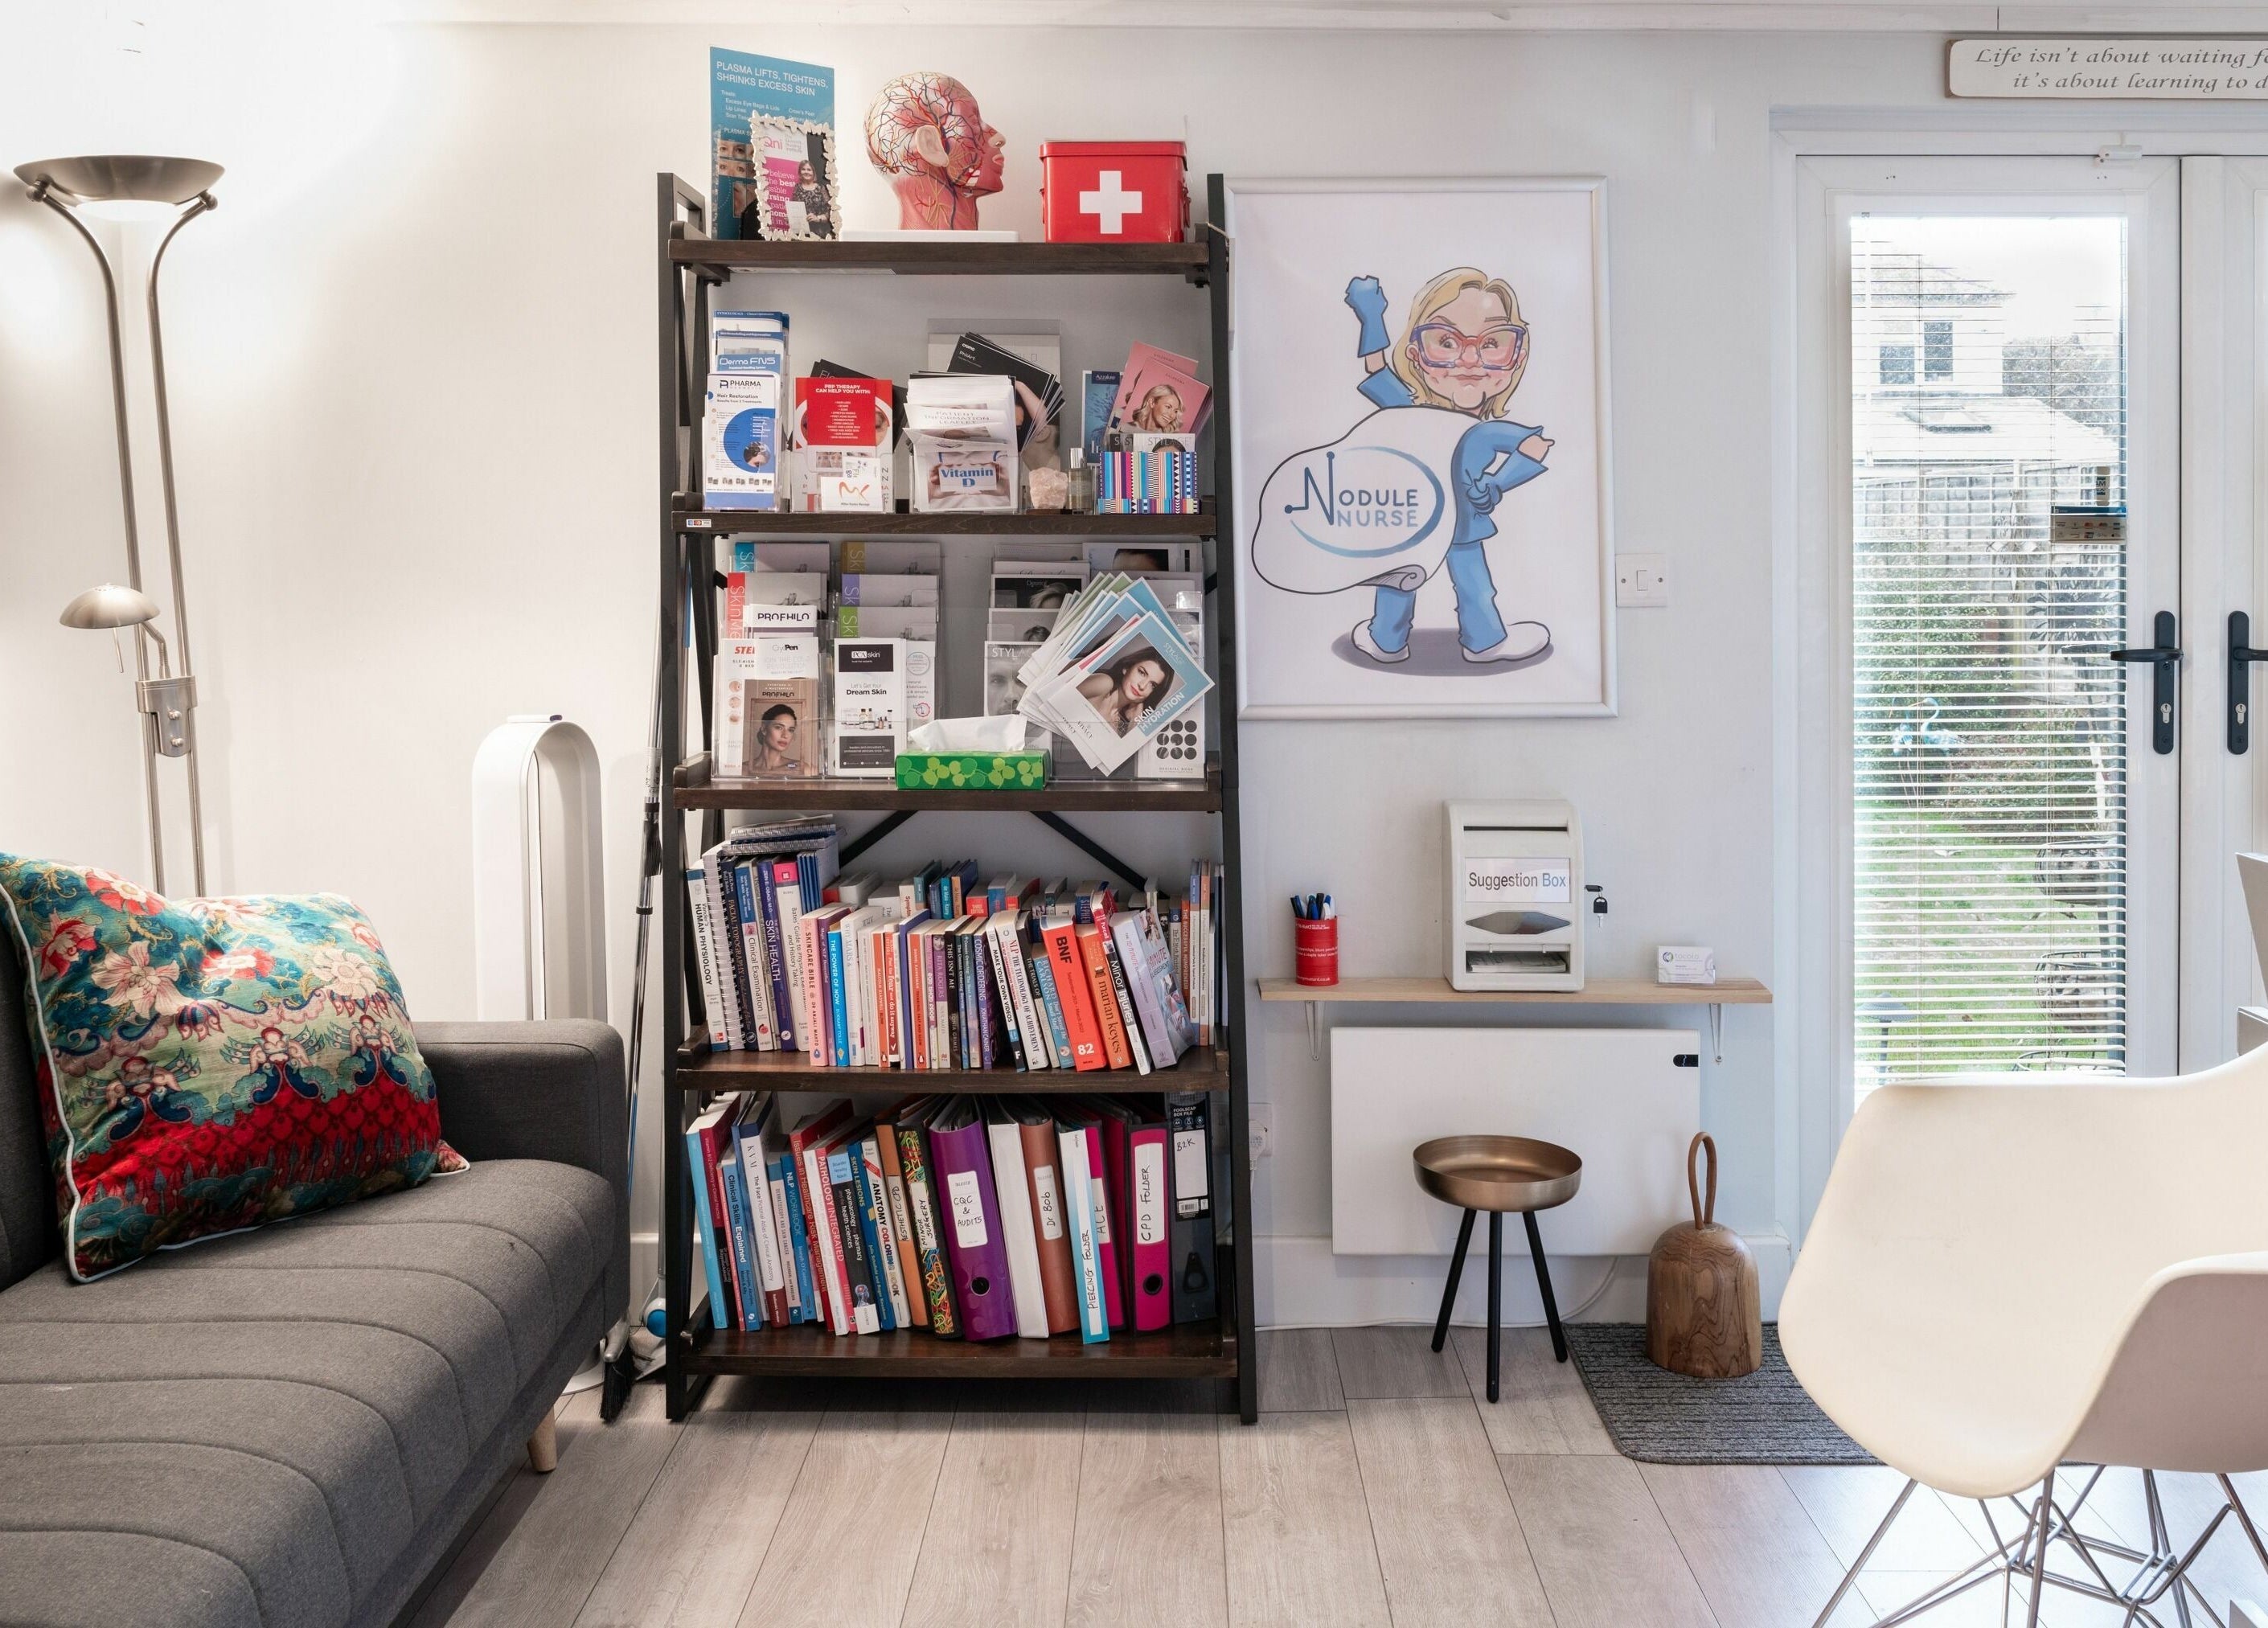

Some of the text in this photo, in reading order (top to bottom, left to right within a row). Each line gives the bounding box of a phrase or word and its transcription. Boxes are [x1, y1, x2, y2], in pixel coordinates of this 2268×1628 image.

[1975, 47, 2245, 68] Life isn't about waiting
[716, 61, 752, 75] PLASMA
[783, 72, 828, 88] TIGHTENS,
[716, 72, 815, 96] SHRINKS EXCESS SKIN
[2013, 72, 2248, 93] it's about learning to
[941, 467, 994, 478] Vitamin
[962, 478, 975, 487] D
[1286, 452, 1419, 525] NODULE
[1336, 510, 1418, 527] NURSE
[1134, 705, 1155, 725] SKIN
[1139, 692, 1185, 732] HYDRATION
[1468, 872, 1567, 891] Suggestion Box
[695, 904, 712, 985] HUMAN PHYSIOLOGY
[728, 900, 744, 974] FACIAL TOPOGRAPHY
[1009, 939, 1019, 954] NLP
[1101, 921, 1109, 940] Purcell
[765, 920, 781, 981] SKIN HEALTH
[806, 933, 814, 966] SKINCARE
[975, 939, 984, 966] COSMIC
[1056, 936, 1072, 964] BNF
[748, 937, 763, 1011] Clinical Examination
[833, 978, 839, 987] OF
[949, 978, 955, 989] ME
[976, 966, 986, 1001] ORDERING
[1015, 968, 1029, 1005] TECHNOLOGY
[1029, 969, 1038, 988] TRIALS
[1035, 988, 1040, 997] OF
[1036, 961, 1051, 1000] CARLSON
[1043, 960, 1056, 999] RICHARD
[889, 1002, 895, 1011] do
[996, 966, 1004, 984] YOUR
[1003, 1000, 1013, 1023] VIDEOS
[1110, 960, 1133, 1023] Minor Injuries
[981, 1007, 989, 1032] JONATHAN
[1023, 1006, 1030, 1014] OF
[1099, 981, 1122, 1053] marian keyes
[1026, 1015, 1040, 1052] ACHIEVEMENT
[1077, 1044, 1094, 1056] 82
[794, 1140, 803, 1165] Issues
[1176, 1138, 1196, 1151] B2K
[801, 1176, 814, 1220] Healthcare
[851, 1157, 865, 1207] SKIN LESIONS
[786, 1172, 802, 1236] NLP WORKBOOK
[818, 1157, 844, 1261] PATHOLOGY INTEGRATED
[892, 1186, 908, 1241] AESTHETIC CPD
[954, 1195, 973, 1205] CQC
[1041, 1191, 1056, 1226] Dr Bob
[1139, 1165, 1152, 1241] CPD FOLDER
[728, 1175, 737, 1203] Clinical
[736, 1226, 747, 1263] Explained
[809, 1221, 818, 1240] Risk
[845, 1189, 863, 1261] pharmacology pharmacy
[872, 1183, 887, 1225] ANATOMY
[882, 1228, 896, 1270] COLORING
[918, 1219, 928, 1246] MINOR
[919, 1199, 933, 1239] SURGERY
[958, 1216, 982, 1227] AUDITS
[845, 1224, 853, 1249] sciences
[812, 1241, 827, 1292] Management
[1081, 1229, 1099, 1310] PIERCING FOLDER
